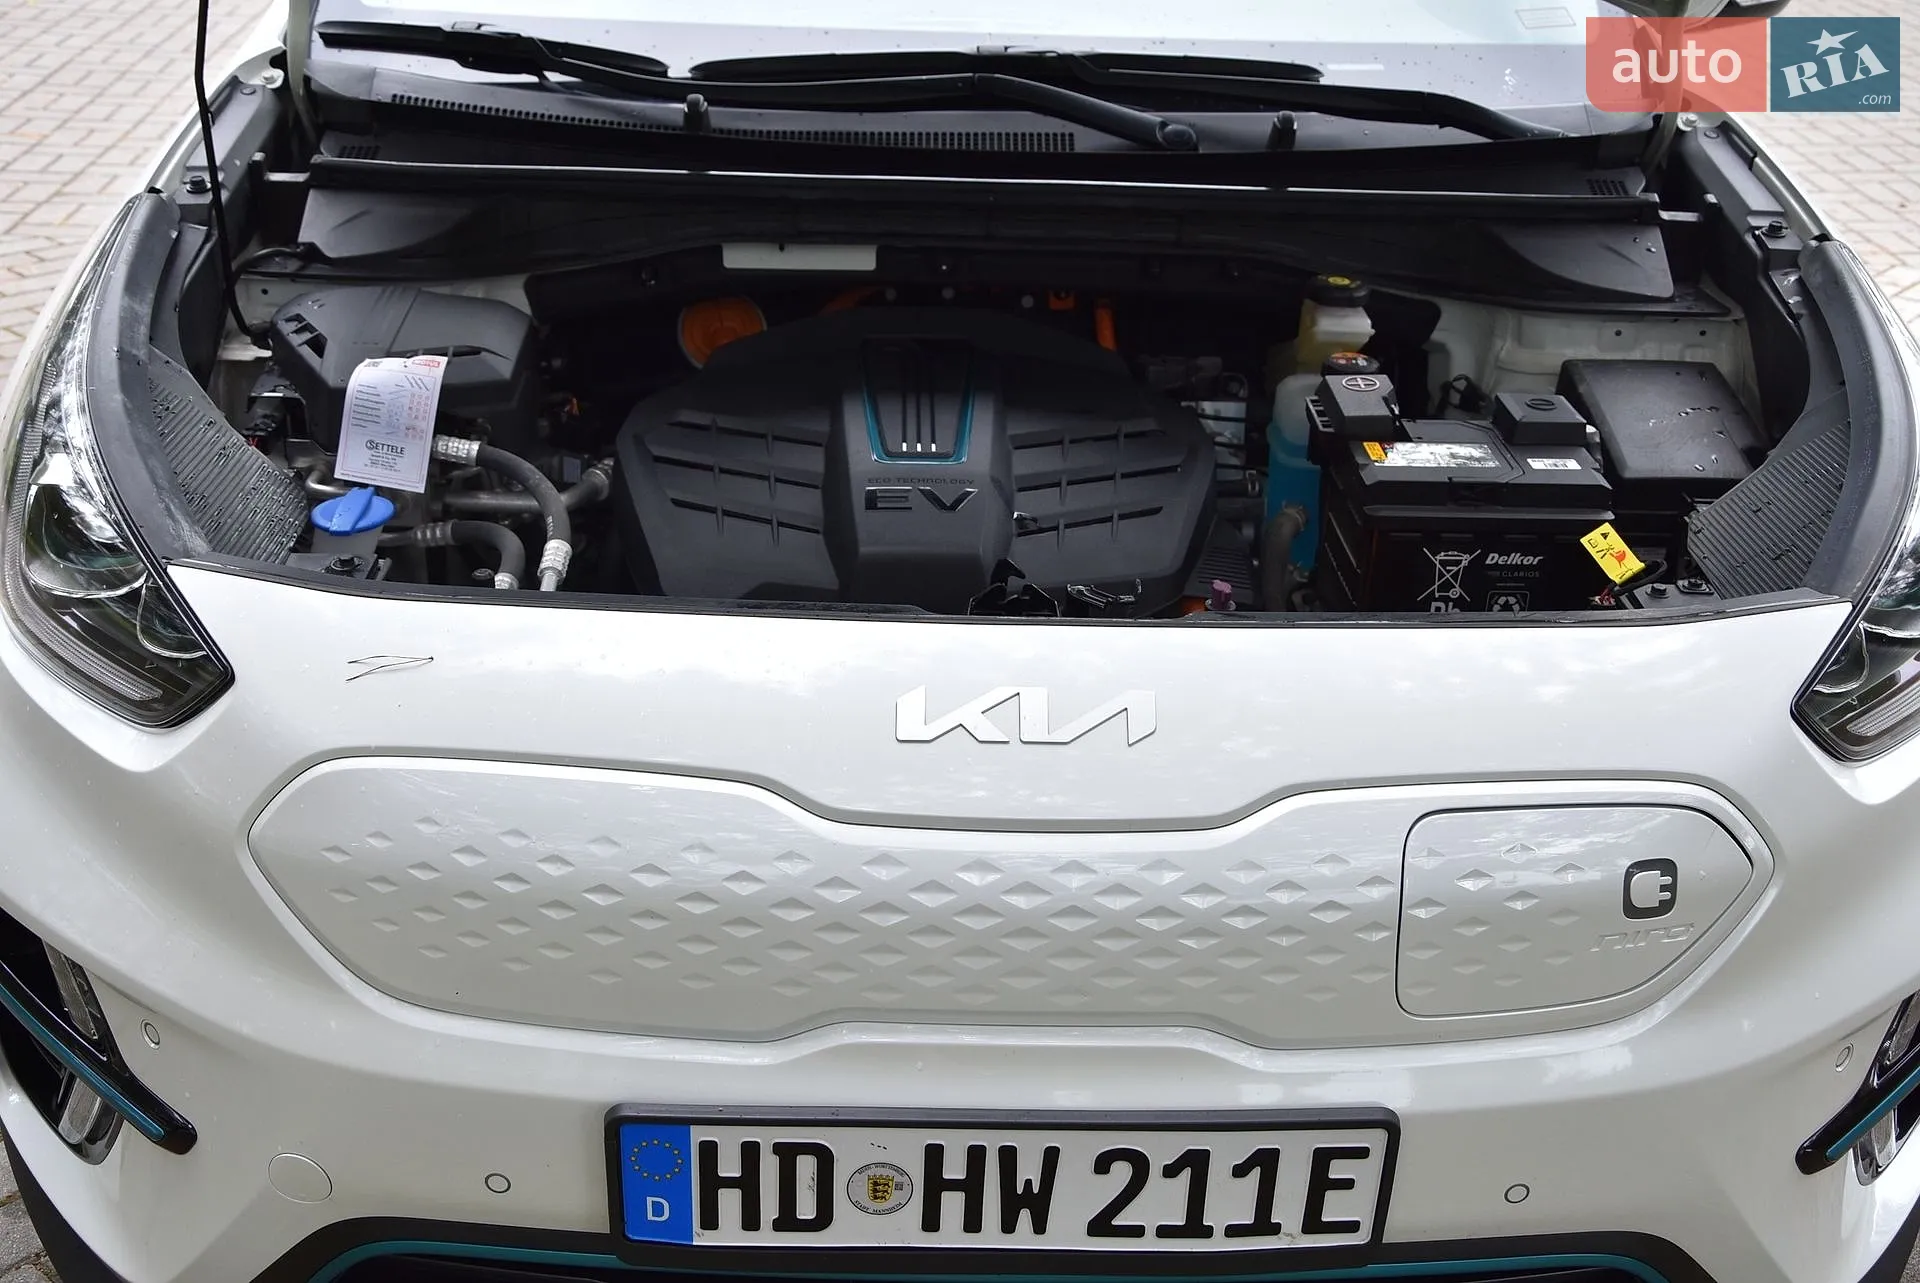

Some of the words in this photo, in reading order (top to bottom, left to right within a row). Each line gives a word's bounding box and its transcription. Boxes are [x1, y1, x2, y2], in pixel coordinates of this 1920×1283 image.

[896, 477, 975, 485] TECHNOLOGY
[865, 485, 979, 512] EV
[1485, 552, 1544, 566] Delkor
[698, 1139, 834, 1233] HD
[921, 1142, 1061, 1241] HW
[1085, 1145, 1372, 1241] 211E
[645, 1196, 671, 1223] D
